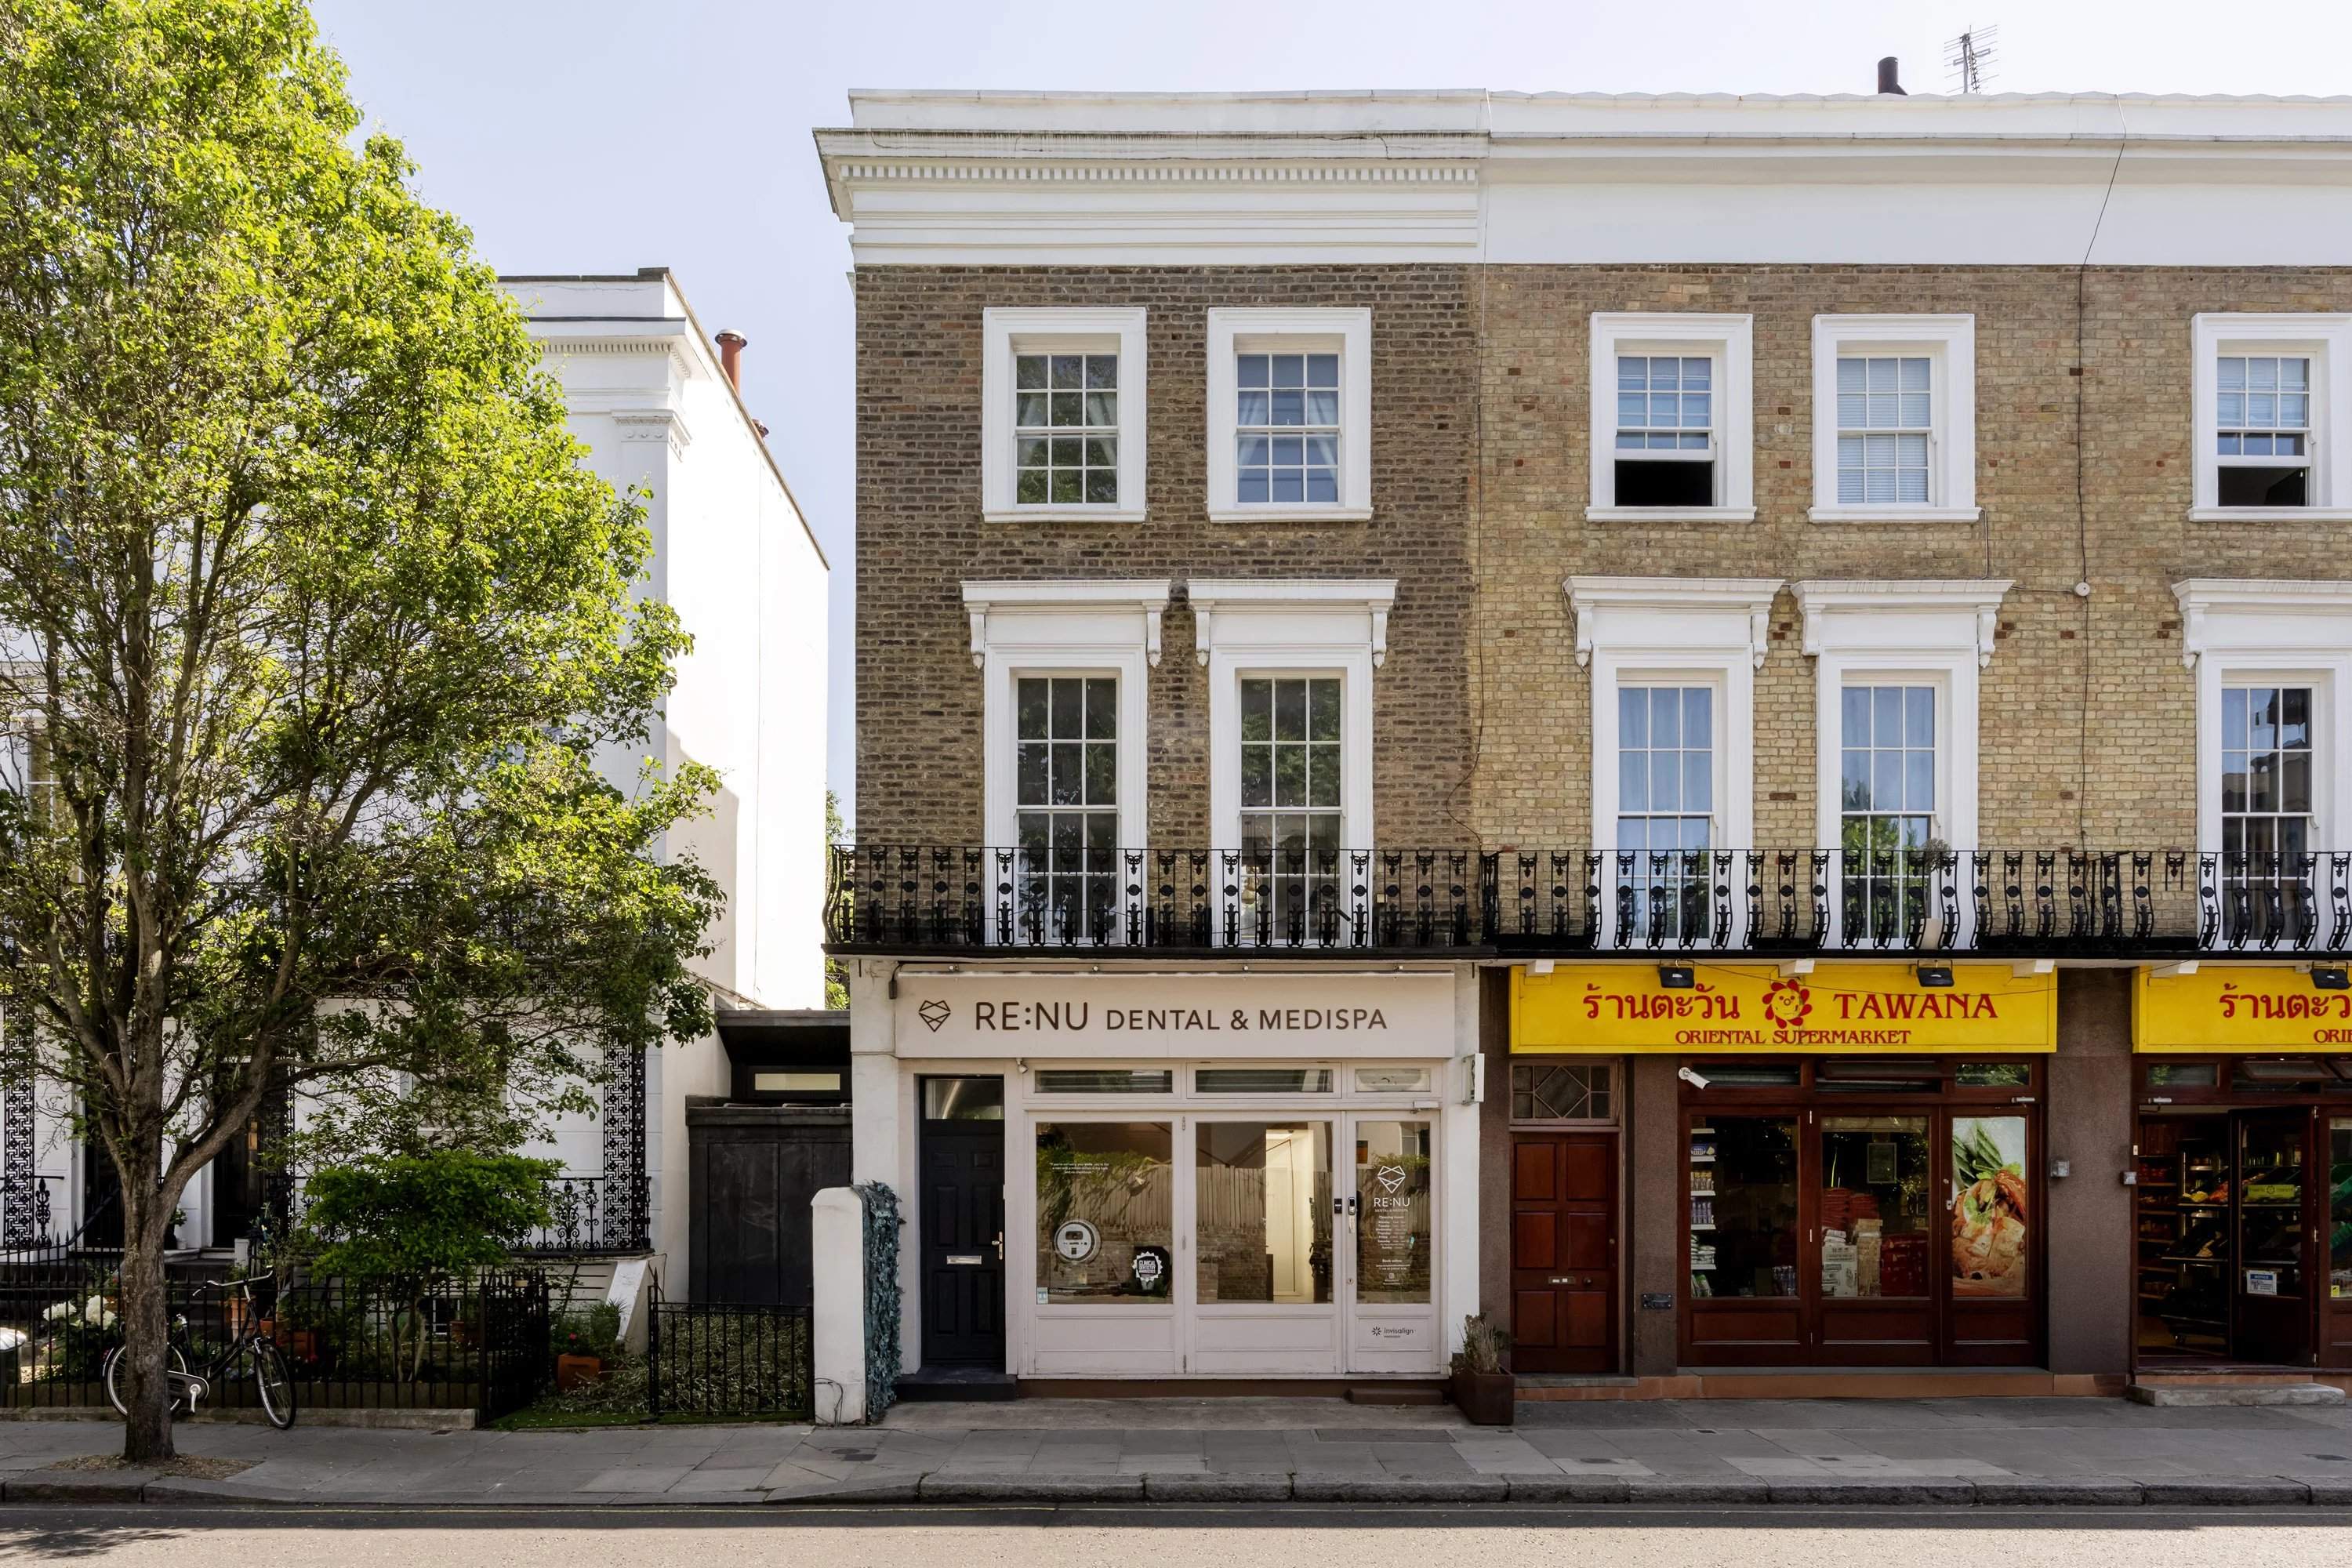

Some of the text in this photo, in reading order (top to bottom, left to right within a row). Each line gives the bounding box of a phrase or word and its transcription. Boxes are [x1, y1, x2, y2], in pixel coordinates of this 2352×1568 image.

[1583, 982, 1740, 1019] ร้านตะวัน
[1833, 993, 1998, 1019] TAWANA
[2219, 982, 2352, 1019] ร้านตะว
[975, 1001, 1388, 1031] RE:NU DENTAL & MEDISPA
[1675, 1029, 1911, 1045] ORIENTAL SUPERMARKET
[1374, 1197, 1410, 1207] RE:NU
[1384, 1327, 1414, 1336] invisalign
